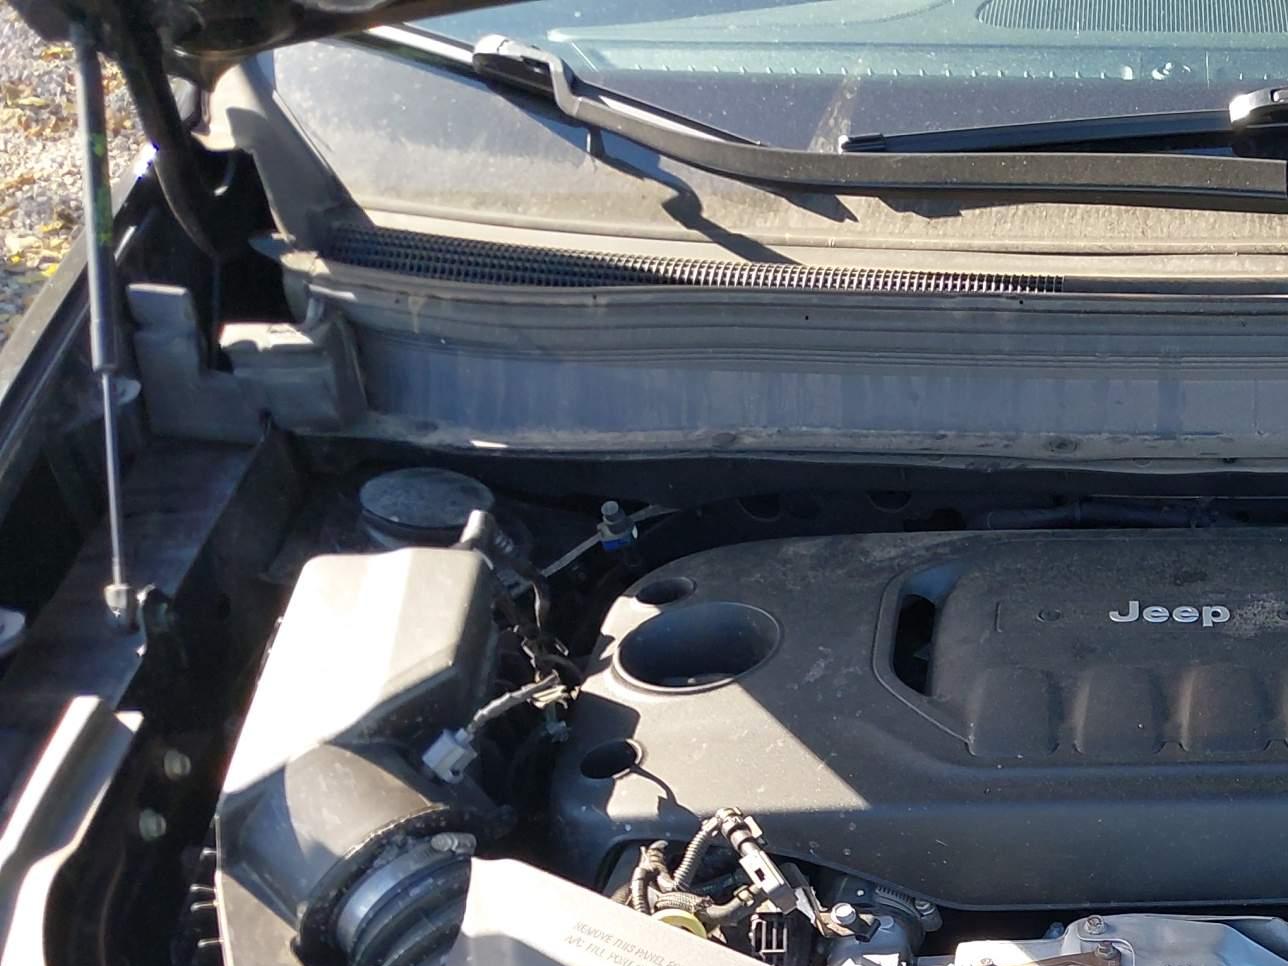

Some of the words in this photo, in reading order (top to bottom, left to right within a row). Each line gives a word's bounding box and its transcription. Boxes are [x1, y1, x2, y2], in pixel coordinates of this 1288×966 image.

[1109, 600, 1230, 627] Jeep
[574, 920, 613, 943] REMOVE
[613, 938, 636, 952] THIS
[634, 947, 664, 966] PANEL
